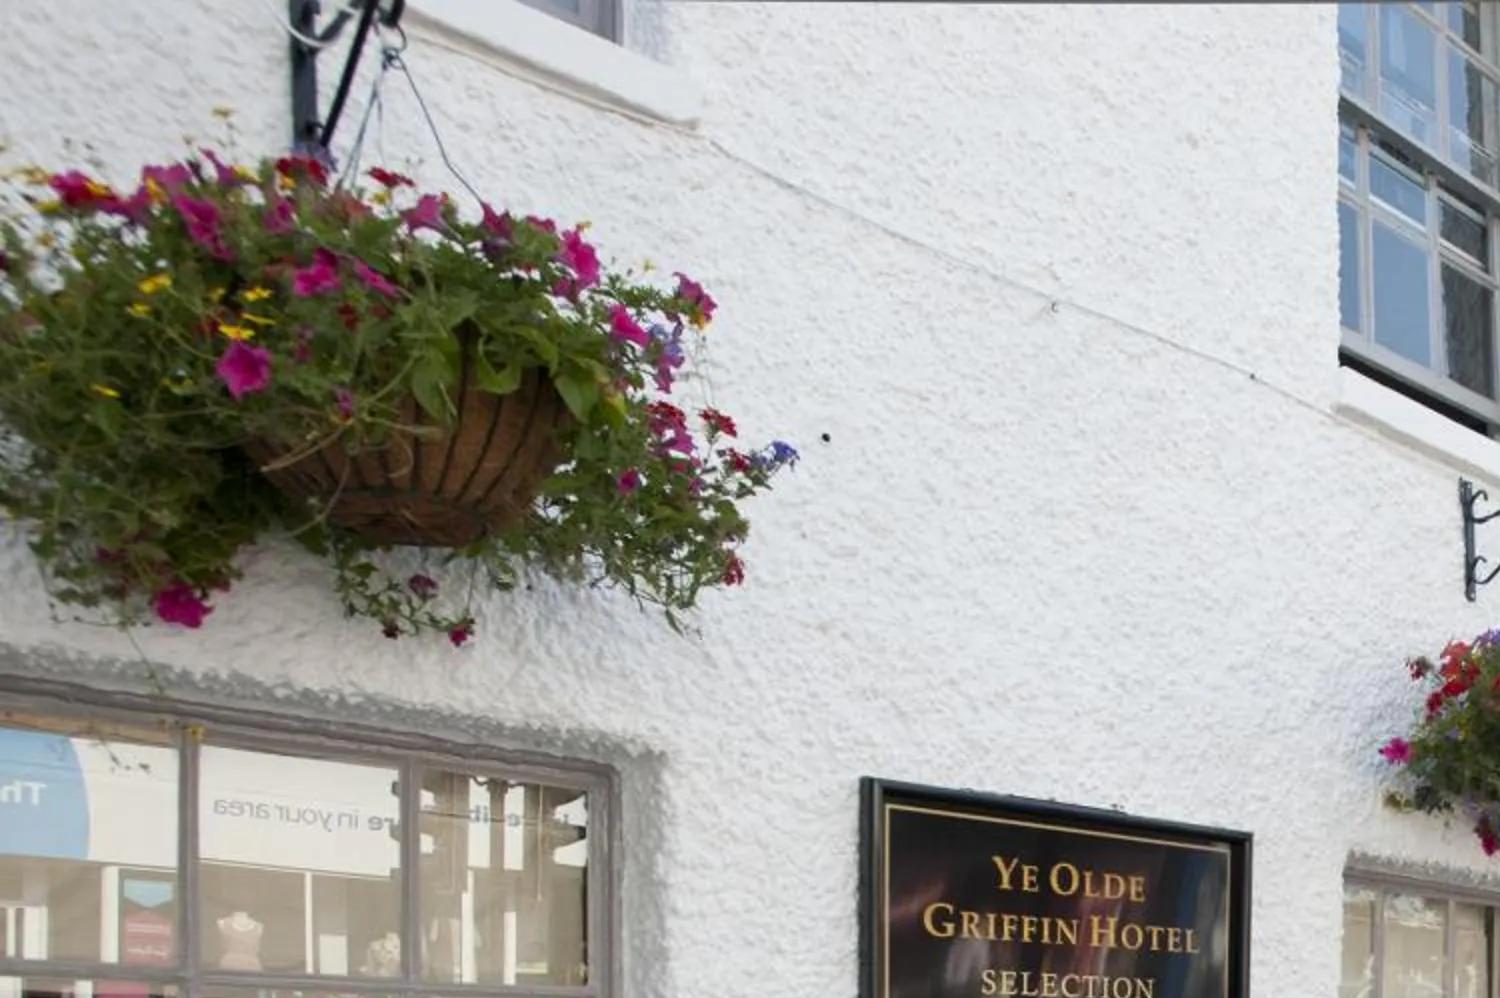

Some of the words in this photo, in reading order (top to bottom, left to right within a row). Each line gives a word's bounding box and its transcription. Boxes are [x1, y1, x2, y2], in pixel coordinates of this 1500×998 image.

[992, 855, 1040, 892] YE
[1050, 863, 1146, 901] OLDE
[923, 902, 1080, 945] GRIFFIN
[1090, 915, 1200, 954] HOTEL
